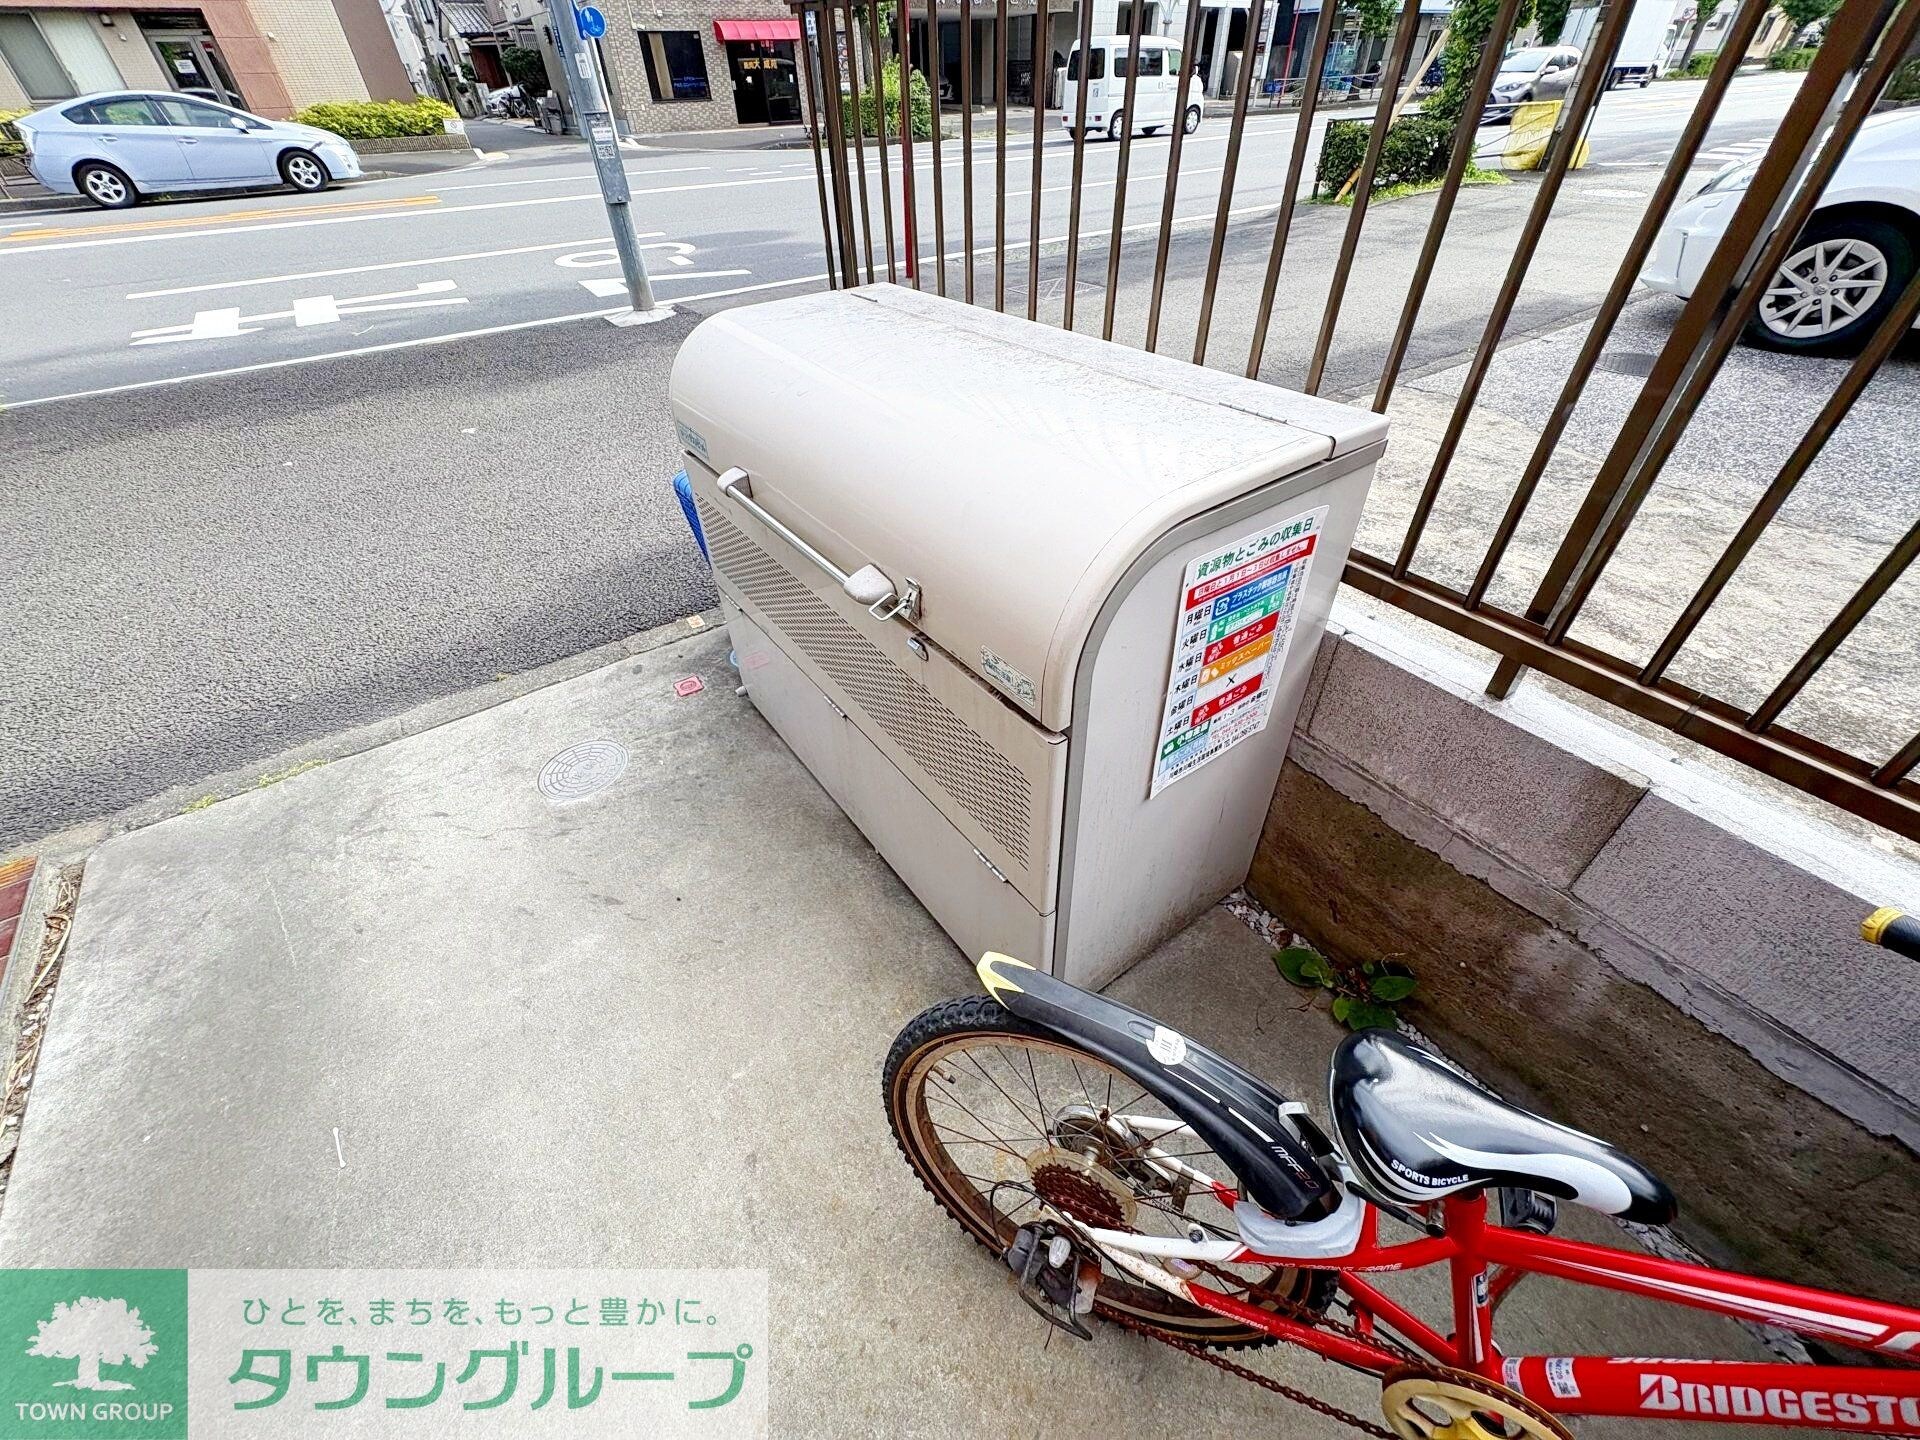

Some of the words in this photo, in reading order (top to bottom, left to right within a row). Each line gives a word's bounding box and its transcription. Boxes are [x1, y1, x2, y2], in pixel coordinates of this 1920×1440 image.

[1197, 518, 1314, 579] 資源物とごみの収集日
[1186, 604, 1211, 625] 月曜日
[1182, 628, 1207, 650] 火曜日
[1233, 624, 1262, 645] 普通ごみ
[1178, 652, 1202, 672] 水曜日
[1221, 641, 1270, 669] ミックスペーパー
[1175, 675, 1198, 693] 木曜日
[1171, 696, 1193, 715] 金曜日
[1219, 685, 1247, 706] 普通ごみ
[1167, 716, 1189, 734] 土曜日
[1390, 1159, 1430, 1187] SPORTS
[1431, 1174, 1469, 1187] BICYCLE
